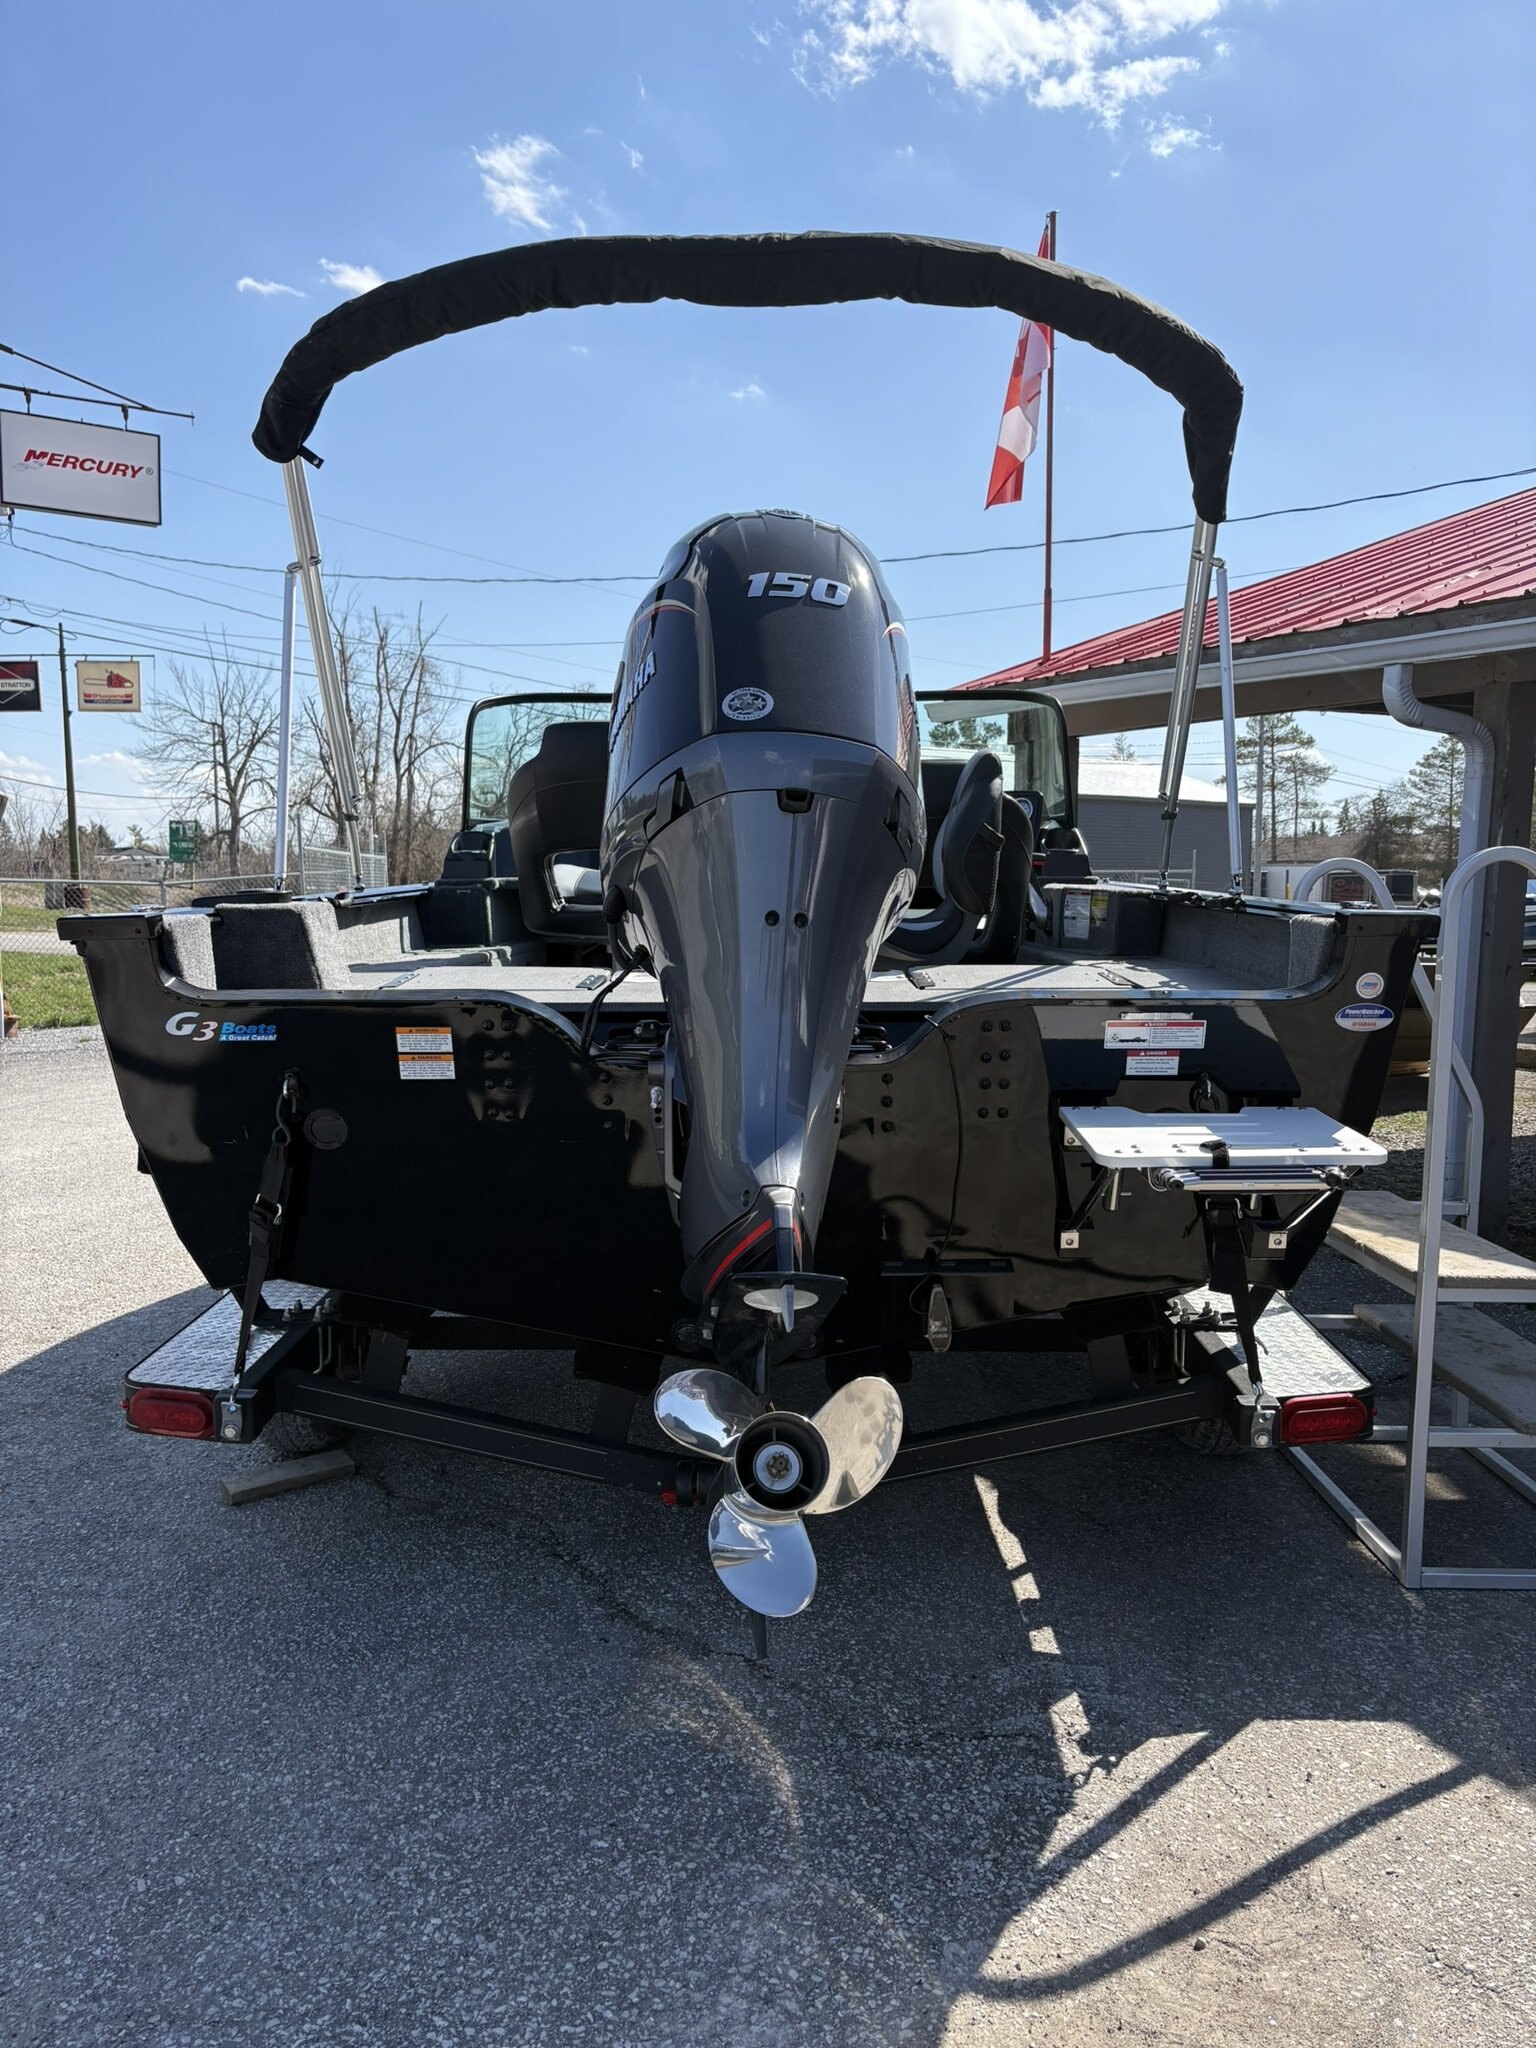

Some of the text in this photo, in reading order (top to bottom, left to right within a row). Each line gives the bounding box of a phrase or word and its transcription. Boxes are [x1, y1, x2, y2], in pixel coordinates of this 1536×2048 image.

[24, 449, 144, 479] MERCURY
[748, 572, 851, 606] 150
[165, 1011, 277, 1041] G3 Boats
